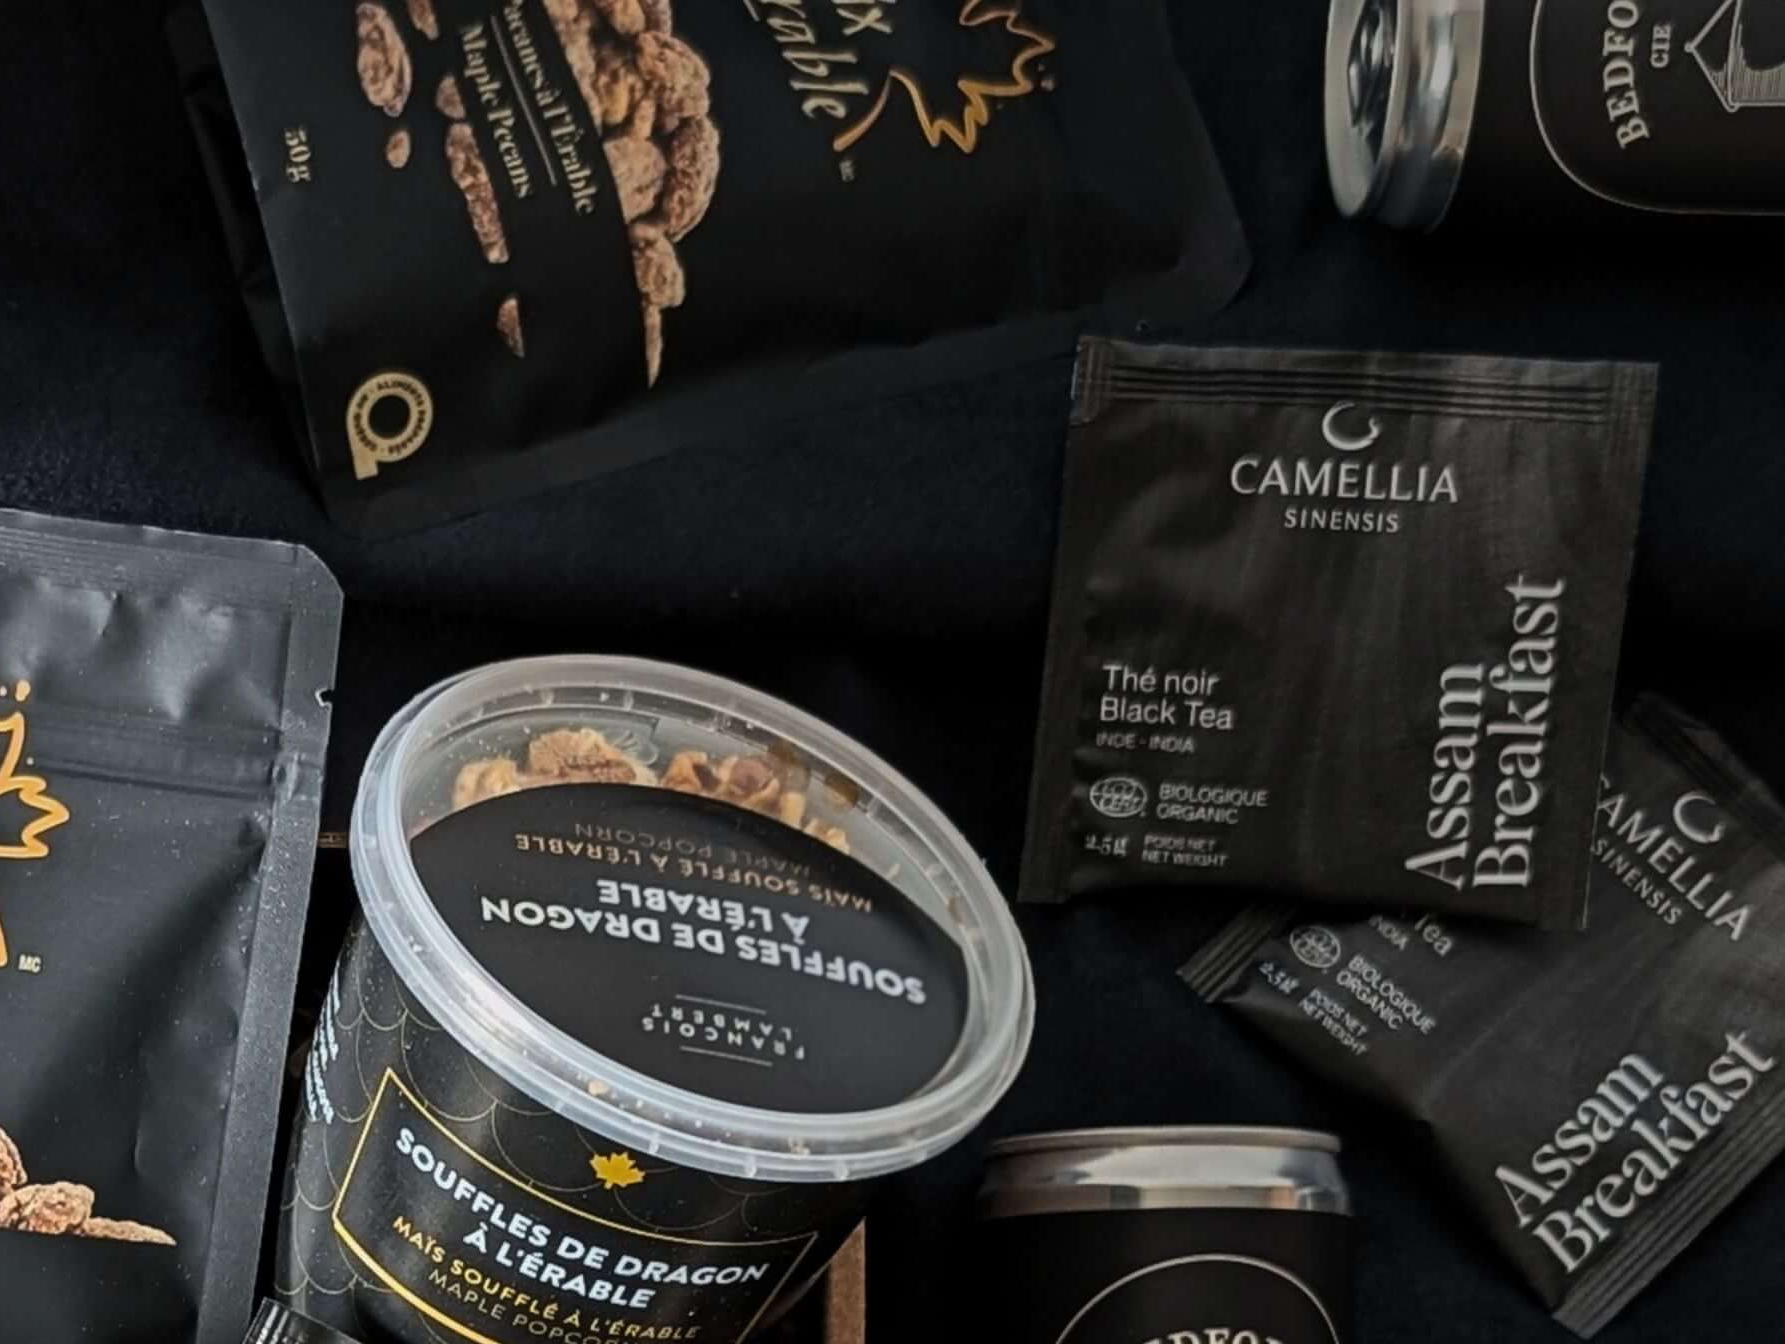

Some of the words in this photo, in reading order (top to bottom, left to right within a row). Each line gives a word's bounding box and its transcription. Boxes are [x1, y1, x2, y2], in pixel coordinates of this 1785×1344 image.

[1649, 22, 1672, 69] CIE
[1228, 457, 1460, 504] CAMELLIA
[1283, 506, 1401, 534] SINENSIS
[1102, 663, 1158, 694] Thé
[1163, 667, 1221, 697] noir
[1099, 697, 1176, 726] Black
[1184, 702, 1234, 731] Tea
[1472, 572, 1567, 888] Breakfast
[1158, 782, 1269, 808] BIOLOGIQUE
[1404, 660, 1485, 890] Assam
[1156, 803, 1239, 825] ORGANIC
[513, 832, 643, 867] L'ÉRABLE
[649, 852, 669, 872] À
[677, 858, 801, 897] SOUFFLÉ
[1590, 838, 1684, 927] SINENSIS
[480, 896, 662, 945] DRAGON
[595, 877, 774, 938] L'ÉRABLE
[781, 912, 811, 946] À
[672, 922, 726, 956] DE
[18, 955, 42, 973] MC
[736, 932, 928, 1007] SOUFFLES
[640, 1014, 806, 1061] FRANCOIS
[649, 1000, 794, 1043] LAMBERT
[1493, 1051, 1664, 1228] Assam
[1531, 1029, 1777, 1275] Breakfast
[395, 1126, 552, 1250] SOUFFLES
[556, 1236, 611, 1271] DE
[614, 1254, 771, 1287] DRAGON
[392, 1215, 447, 1265] MAÏS
[450, 1254, 560, 1323] SOUFFLÉ
[562, 1306, 582, 1328] À
[589, 1317, 703, 1342] L'ÉRABLE
[462, 1221, 488, 1259] À
[495, 1244, 657, 1311] L'ÉRABLE
[428, 1270, 507, 1321] MAPLE
